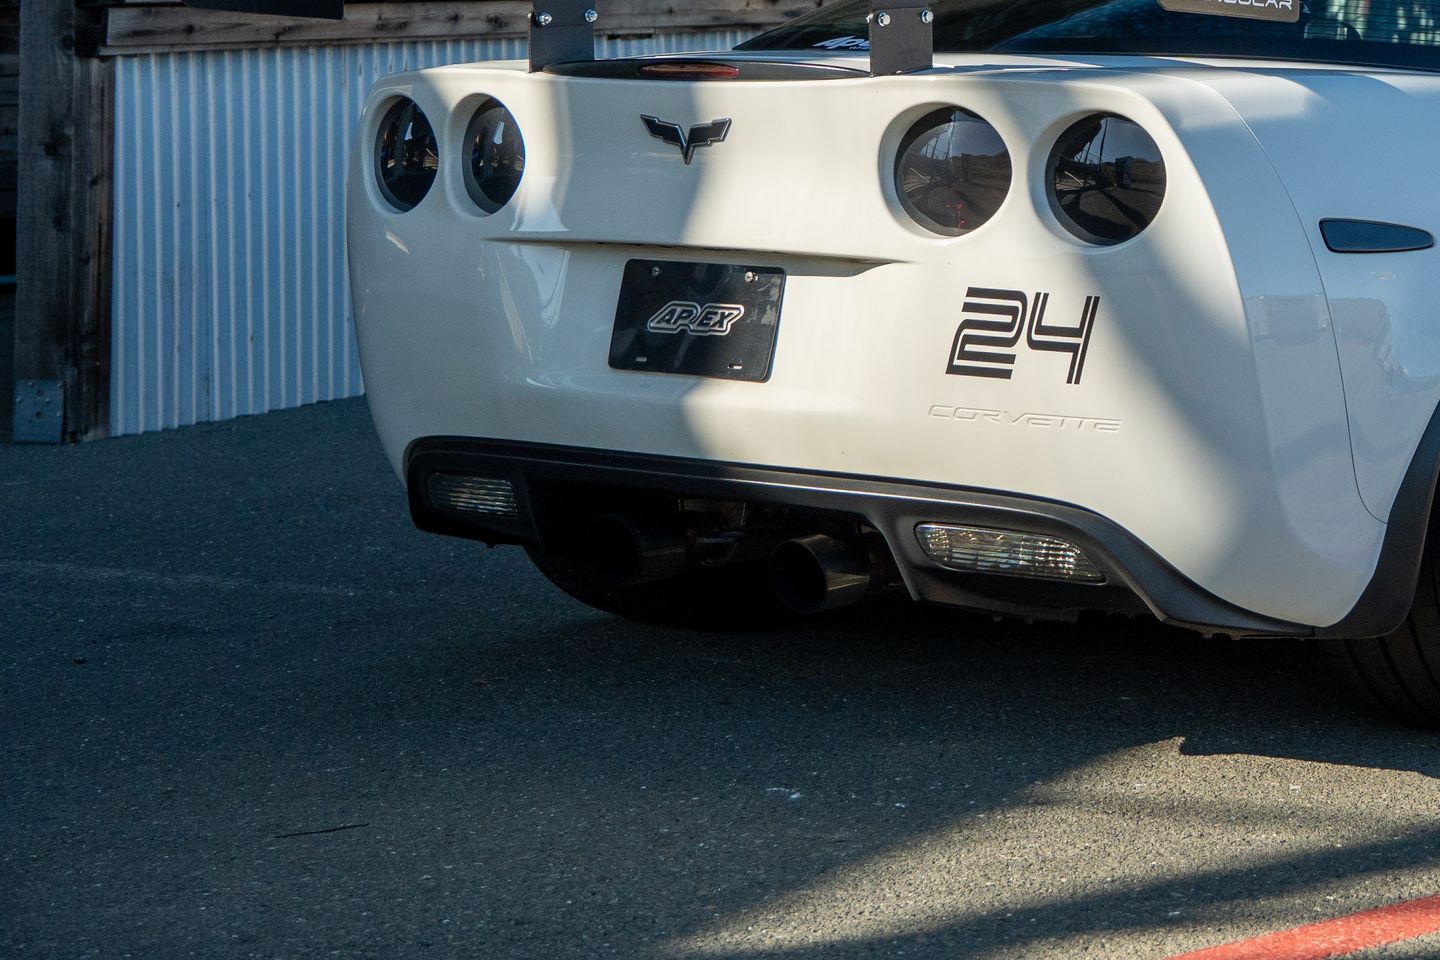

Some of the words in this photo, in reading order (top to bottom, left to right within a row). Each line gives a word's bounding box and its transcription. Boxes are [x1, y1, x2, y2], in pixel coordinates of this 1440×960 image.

[650, 302, 741, 333] APEX
[945, 286, 1100, 385] 24
[928, 404, 1123, 432] CORVETTE
